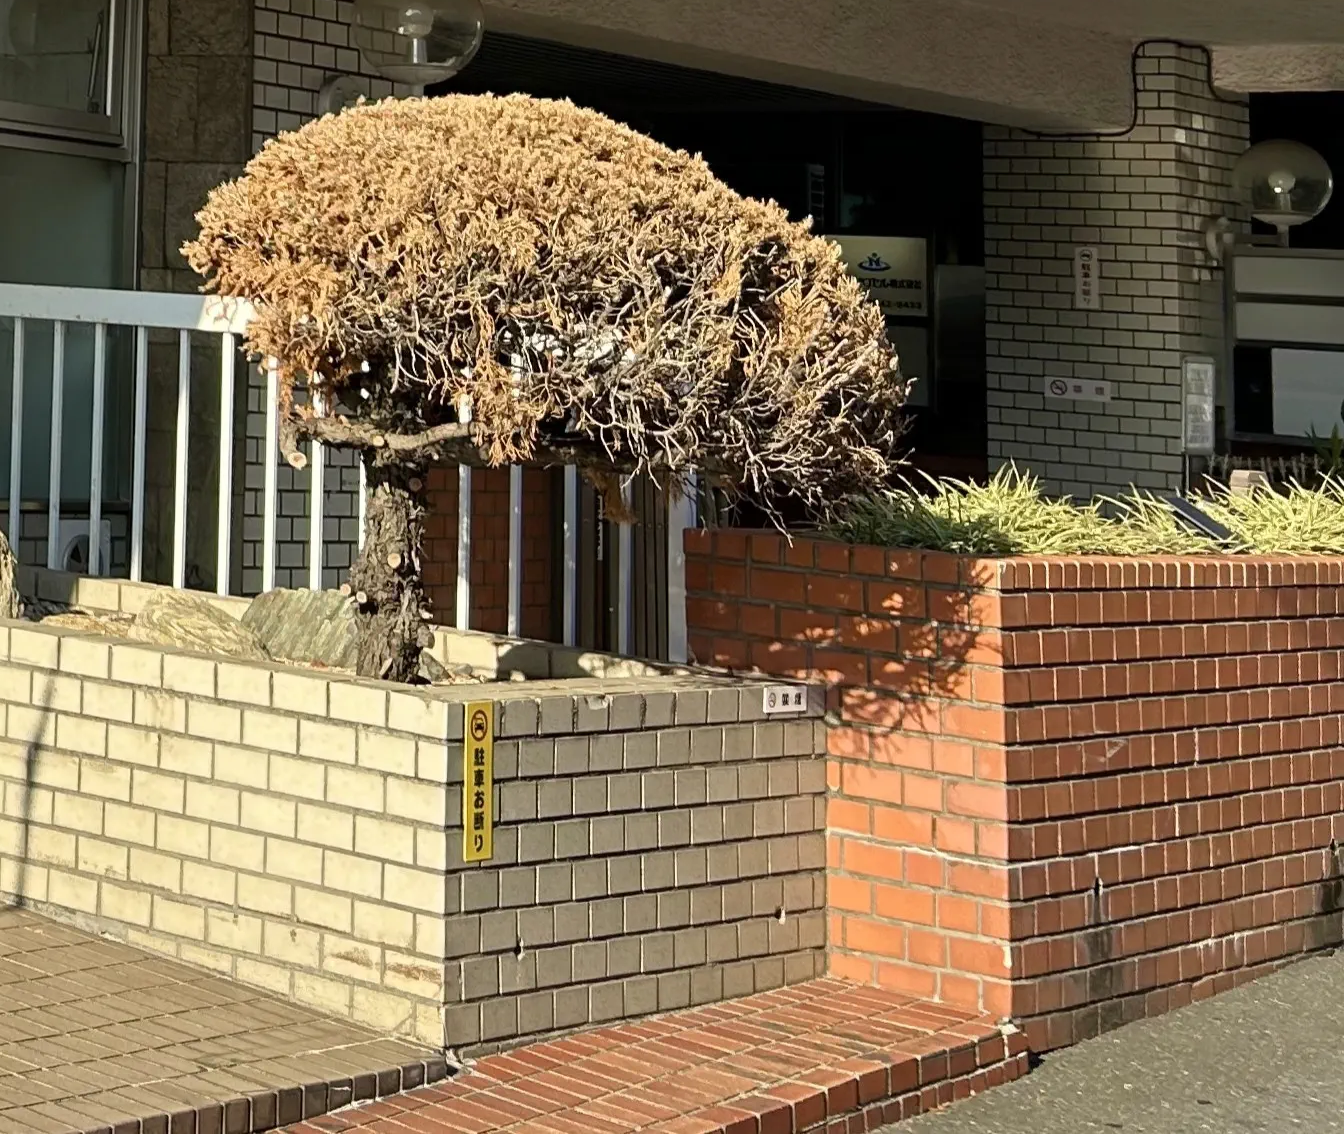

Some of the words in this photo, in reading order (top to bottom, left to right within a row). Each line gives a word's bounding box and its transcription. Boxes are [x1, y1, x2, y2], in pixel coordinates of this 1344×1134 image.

[473, 746, 486, 853] 駐車お断り
